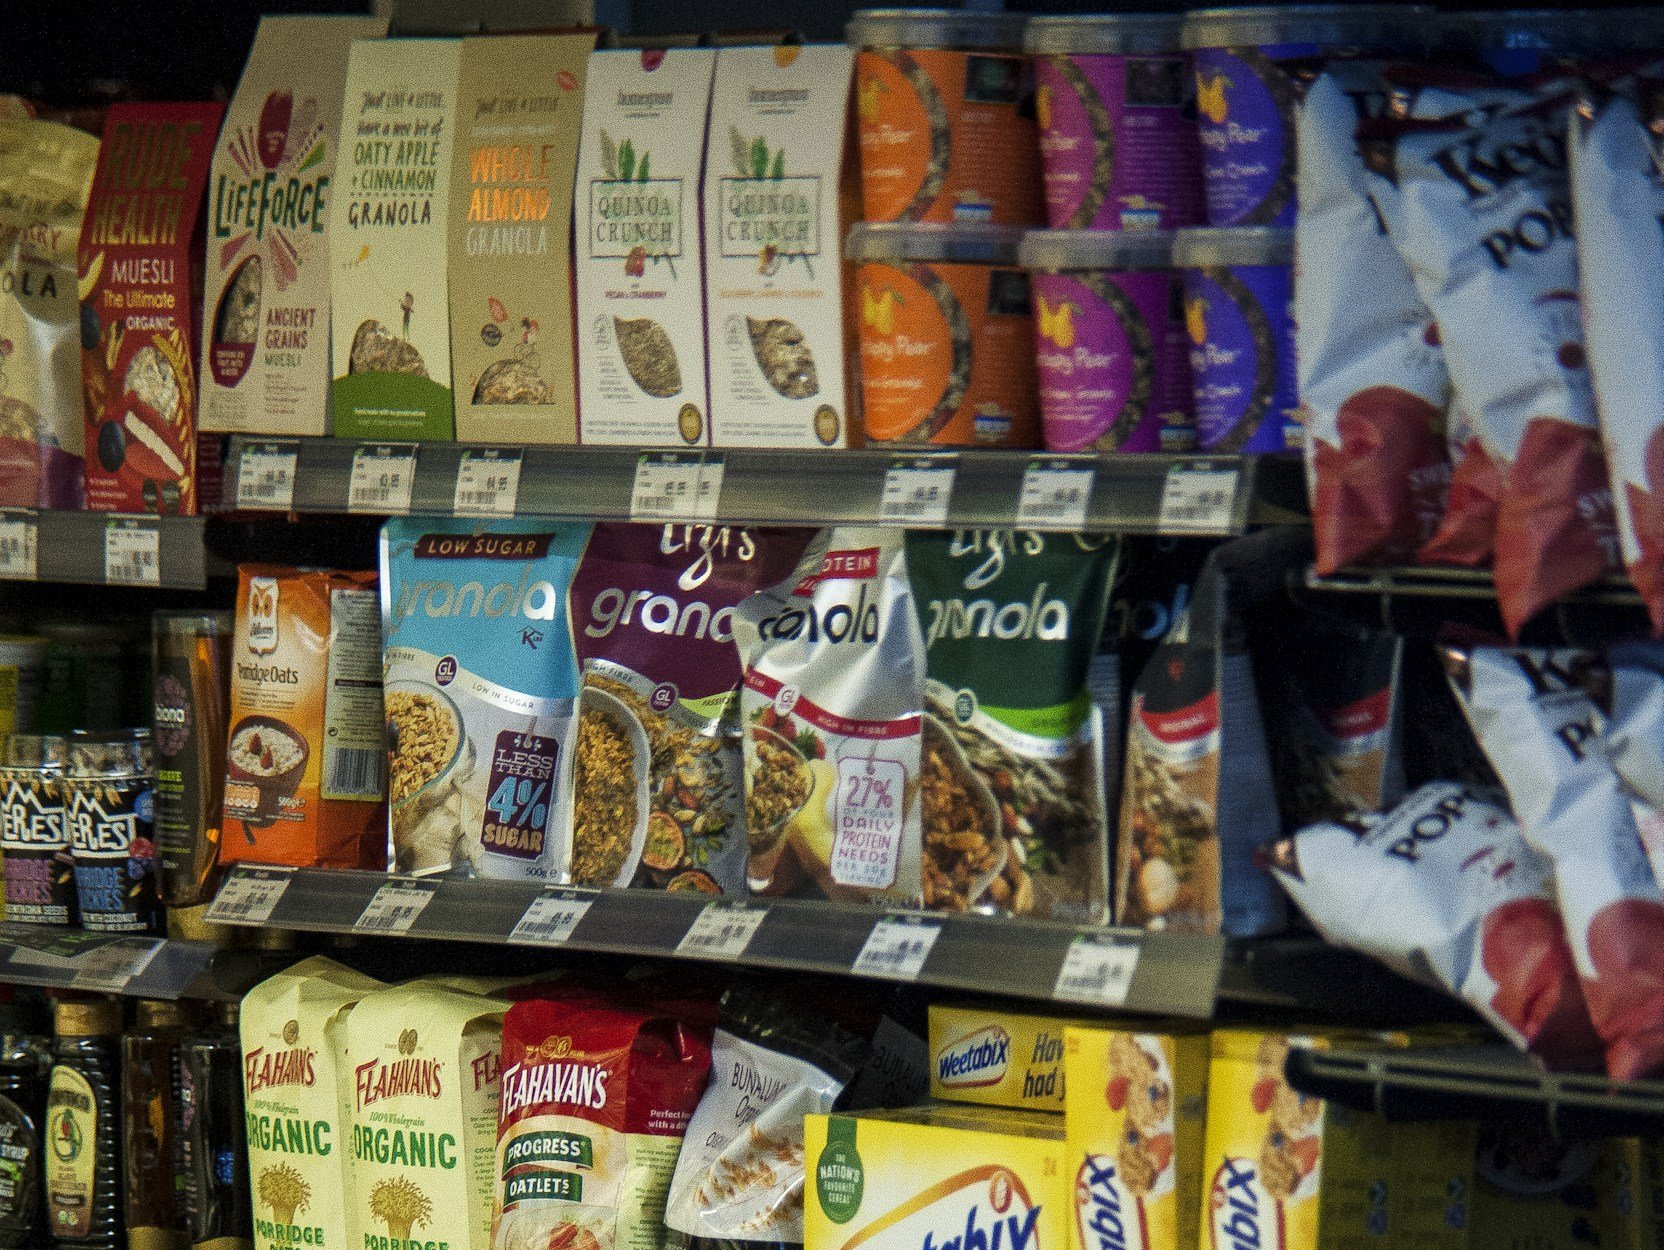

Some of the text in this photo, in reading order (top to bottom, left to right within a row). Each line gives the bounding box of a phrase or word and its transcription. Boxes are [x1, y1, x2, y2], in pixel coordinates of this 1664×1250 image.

[354, 141, 439, 167] OATY APPLE
[470, 143, 556, 184] WHOLE
[361, 170, 437, 192] CINNAMON
[349, 202, 432, 228] GRANOLA
[466, 187, 552, 223] ALMOND
[598, 195, 672, 220] QUINOA
[728, 194, 810, 218] QUINOA
[466, 225, 549, 255] GRANOLA
[596, 221, 674, 244] CRUNCH
[726, 219, 810, 243] CRUNCH
[111, 259, 175, 285] MUESLI
[103, 289, 176, 309] The Ultimate
[126, 315, 176, 331] ORGANIC
[266, 306, 316, 329] ANCIENT
[265, 329, 308, 351] GRAINS
[428, 537, 537, 556] LOW SUGAR
[270, 666, 299, 685] Oats
[504, 695, 535, 709] SUGAR
[497, 750, 553, 770] LESS
[496, 764, 550, 781] THAN
[486, 776, 546, 827] 4%
[847, 775, 894, 809] 27%
[843, 817, 894, 832] DAILY
[484, 823, 543, 852] SUGAR
[841, 831, 892, 849] PROTEIN
[838, 848, 889, 865] NEEDS
[939, 1035, 1064, 1078] Weetabix Hav
[354, 1058, 445, 1113] FLAHAVAN'S
[500, 1061, 608, 1124] FLAHAVAN'S
[1022, 1072, 1059, 1099] had
[648, 1119, 670, 1129] with
[650, 1108, 681, 1121] Perfect
[247, 1117, 332, 1157] ORGANIC
[354, 1123, 459, 1170] ORGANIC
[507, 1137, 582, 1165] PROGRESS
[820, 1163, 862, 1184] NATION'S
[509, 1177, 571, 1199] OATLETS
[256, 1218, 326, 1248] PORRIDGE
